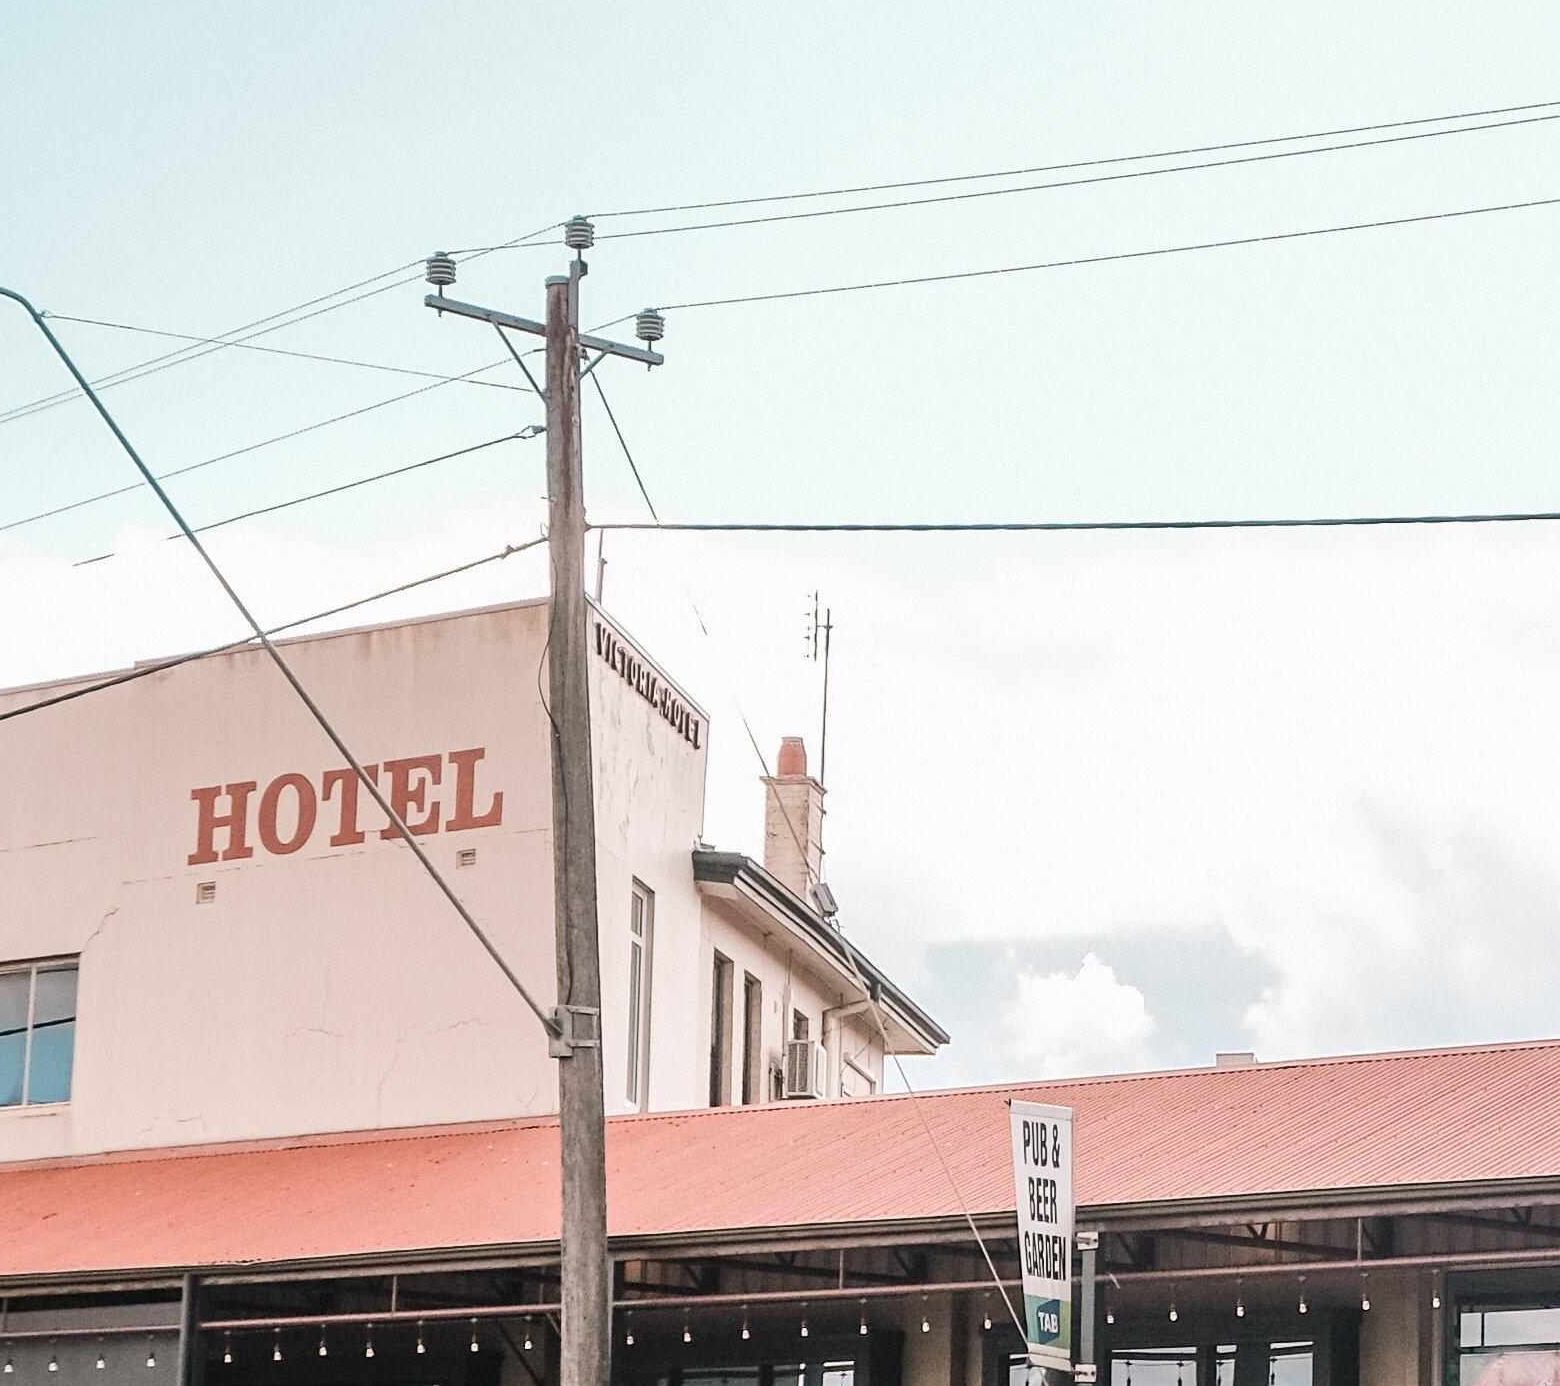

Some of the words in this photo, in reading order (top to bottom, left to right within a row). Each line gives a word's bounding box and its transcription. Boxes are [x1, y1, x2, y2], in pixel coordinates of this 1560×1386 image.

[594, 623, 659, 709] VICTORIA
[658, 687, 701, 750] HOTEL
[187, 746, 504, 866] HOTEL
[1022, 1119, 1048, 1168] PUB
[1051, 1124, 1061, 1168] &
[1027, 1176, 1058, 1225] BEER
[1023, 1229, 1067, 1282] GARDEN
[1037, 1310, 1059, 1335] TAB
